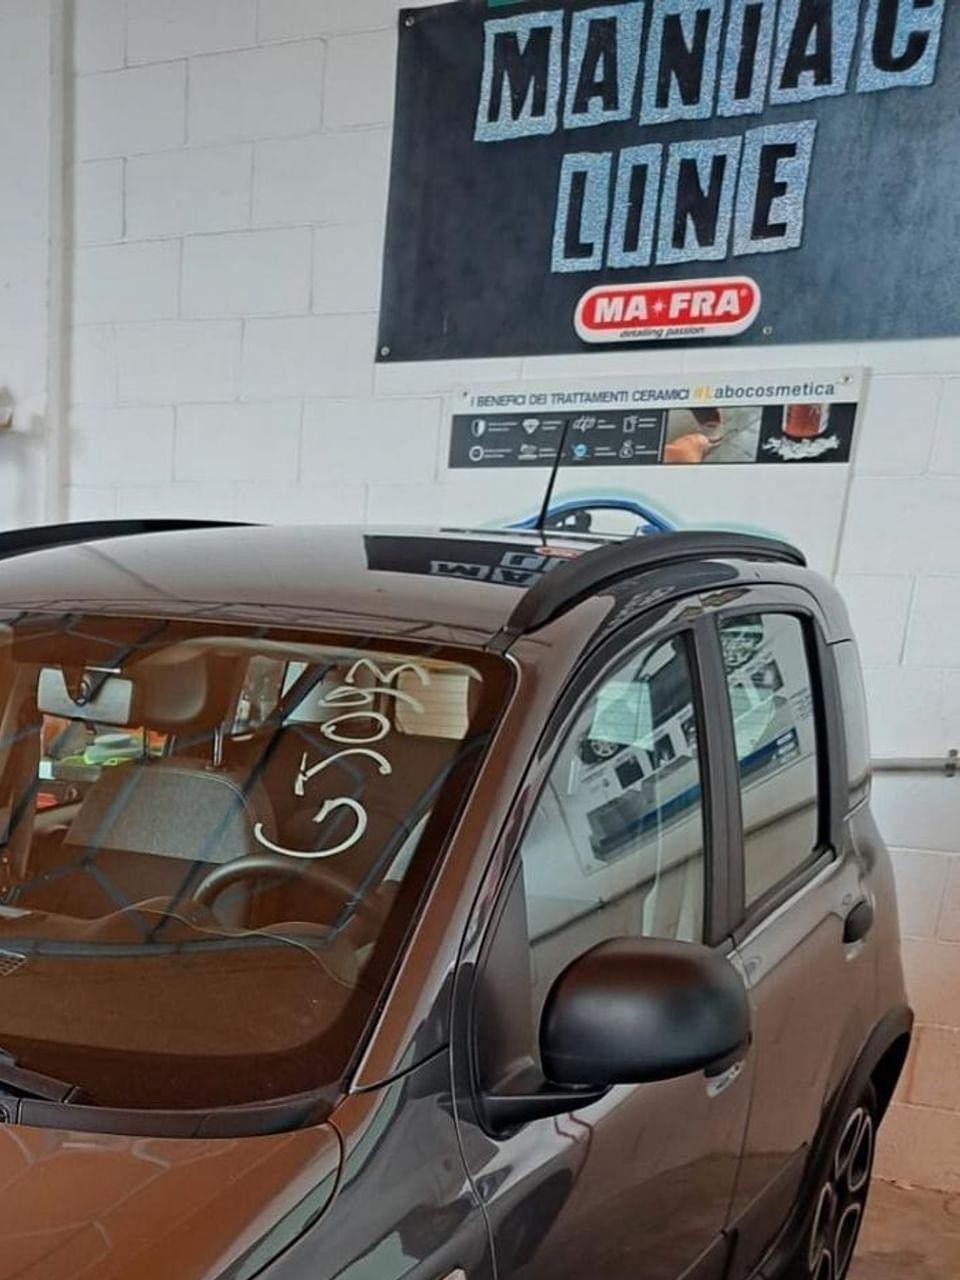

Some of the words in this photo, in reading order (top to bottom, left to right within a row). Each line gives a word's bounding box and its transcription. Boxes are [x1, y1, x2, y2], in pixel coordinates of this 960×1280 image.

[484, 0, 935, 124] MANIAC
[560, 140, 801, 261] LINE
[551, 390, 628, 405] TRATTAMENTI
[632, 387, 689, 402] CERAMICI
